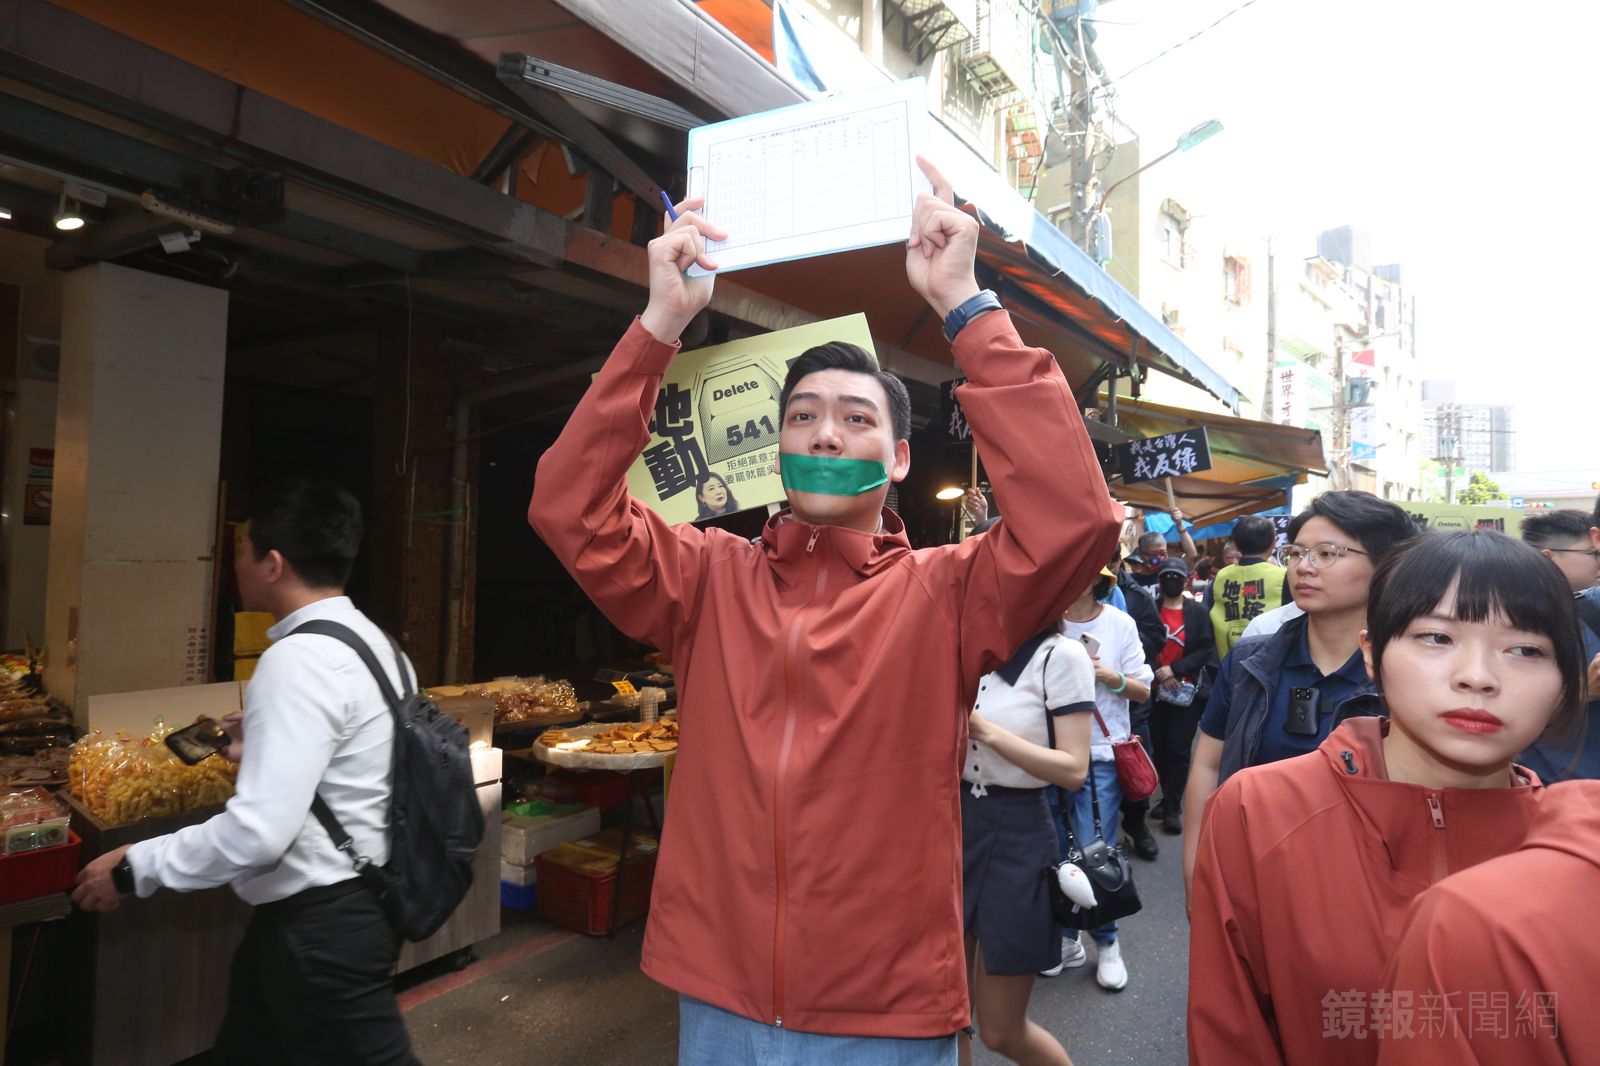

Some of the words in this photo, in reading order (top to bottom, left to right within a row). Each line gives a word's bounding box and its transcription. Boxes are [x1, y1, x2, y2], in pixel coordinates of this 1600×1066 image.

[712, 381, 760, 401] Delete
[644, 382, 711, 502] 地動
[726, 415, 775, 447] 541
[1129, 433, 1196, 455] 我是台灣人
[1134, 447, 1198, 479] 我反綠
